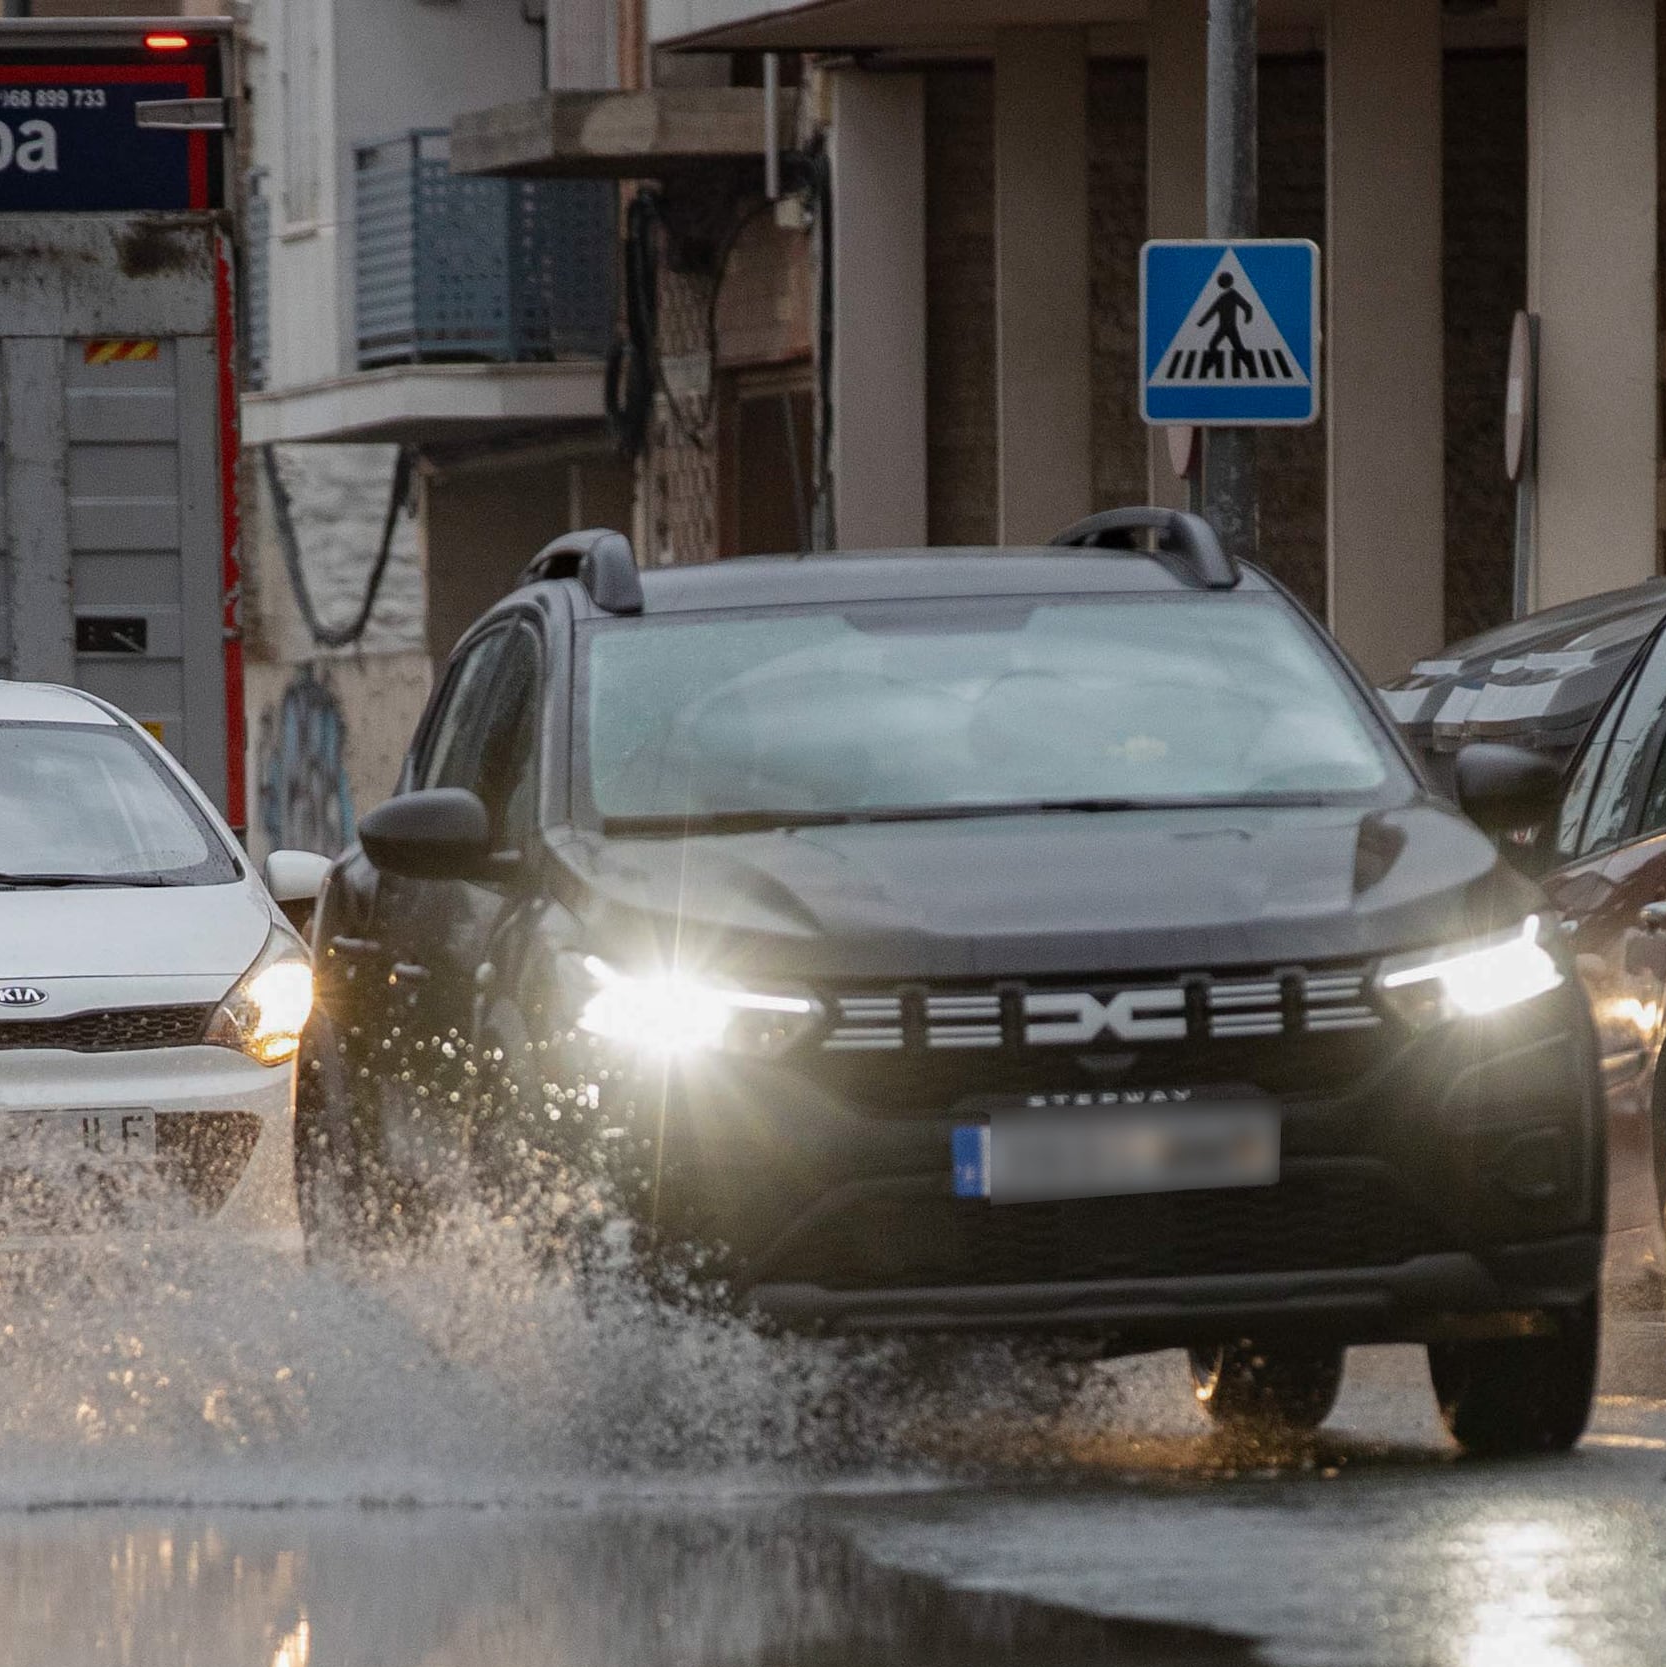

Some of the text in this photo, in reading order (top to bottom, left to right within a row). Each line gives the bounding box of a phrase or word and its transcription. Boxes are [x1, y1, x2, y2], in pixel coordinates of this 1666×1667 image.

[35, 89, 69, 108] 899
[72, 89, 107, 107] 733
[1025, 1089, 1191, 1106] STEPWAY
